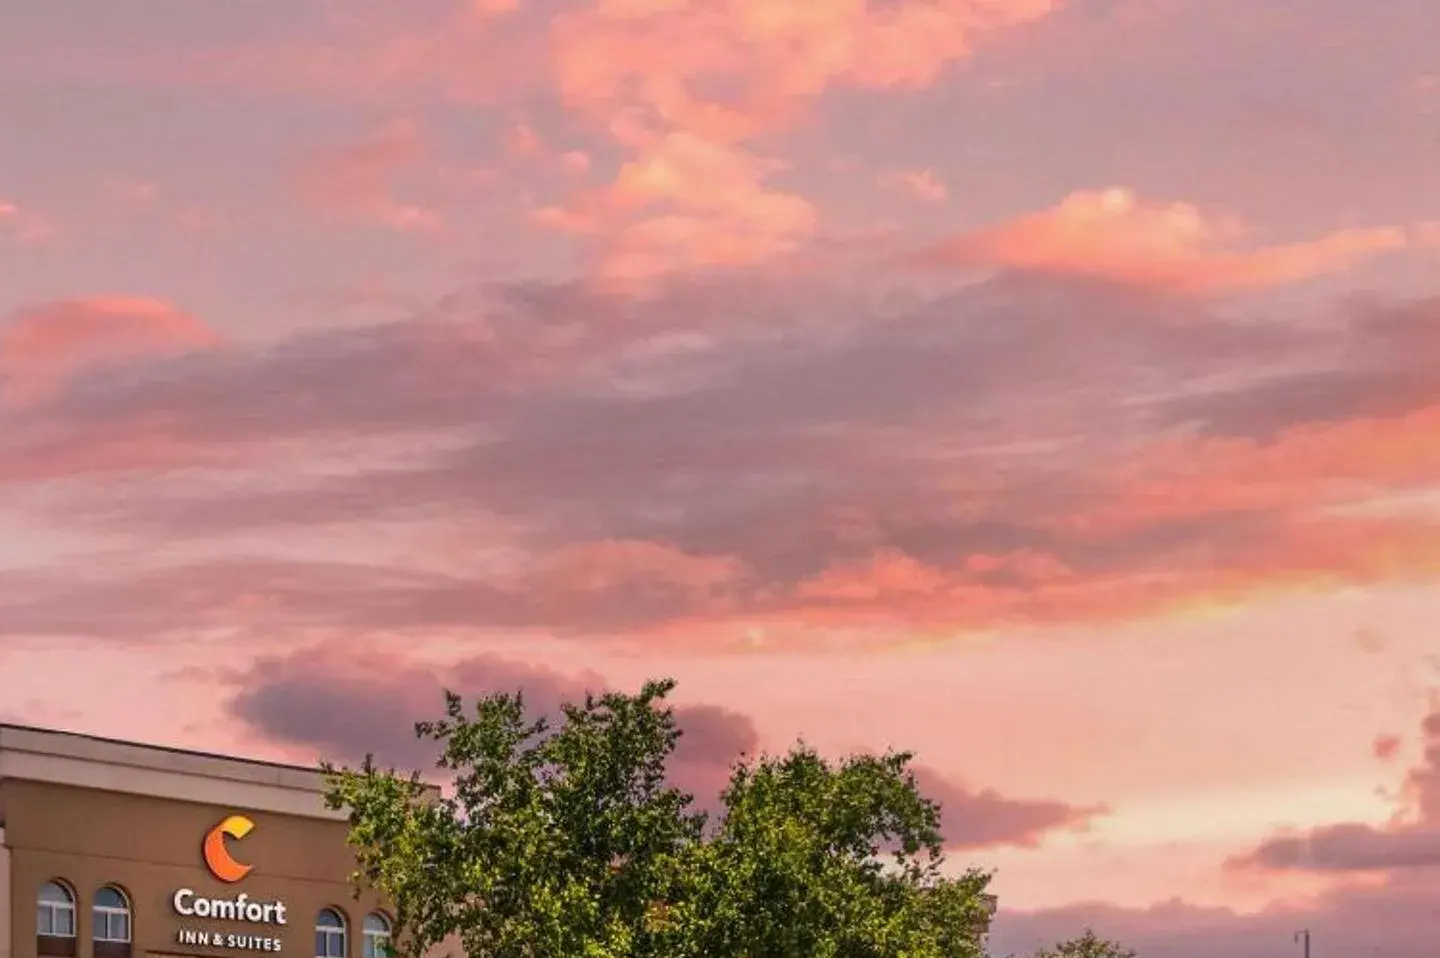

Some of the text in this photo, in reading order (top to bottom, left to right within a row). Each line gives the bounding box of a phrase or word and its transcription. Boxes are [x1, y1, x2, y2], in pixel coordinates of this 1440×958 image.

[173, 887, 287, 925] Comfort
[178, 929, 282, 952] INN & SUITES
